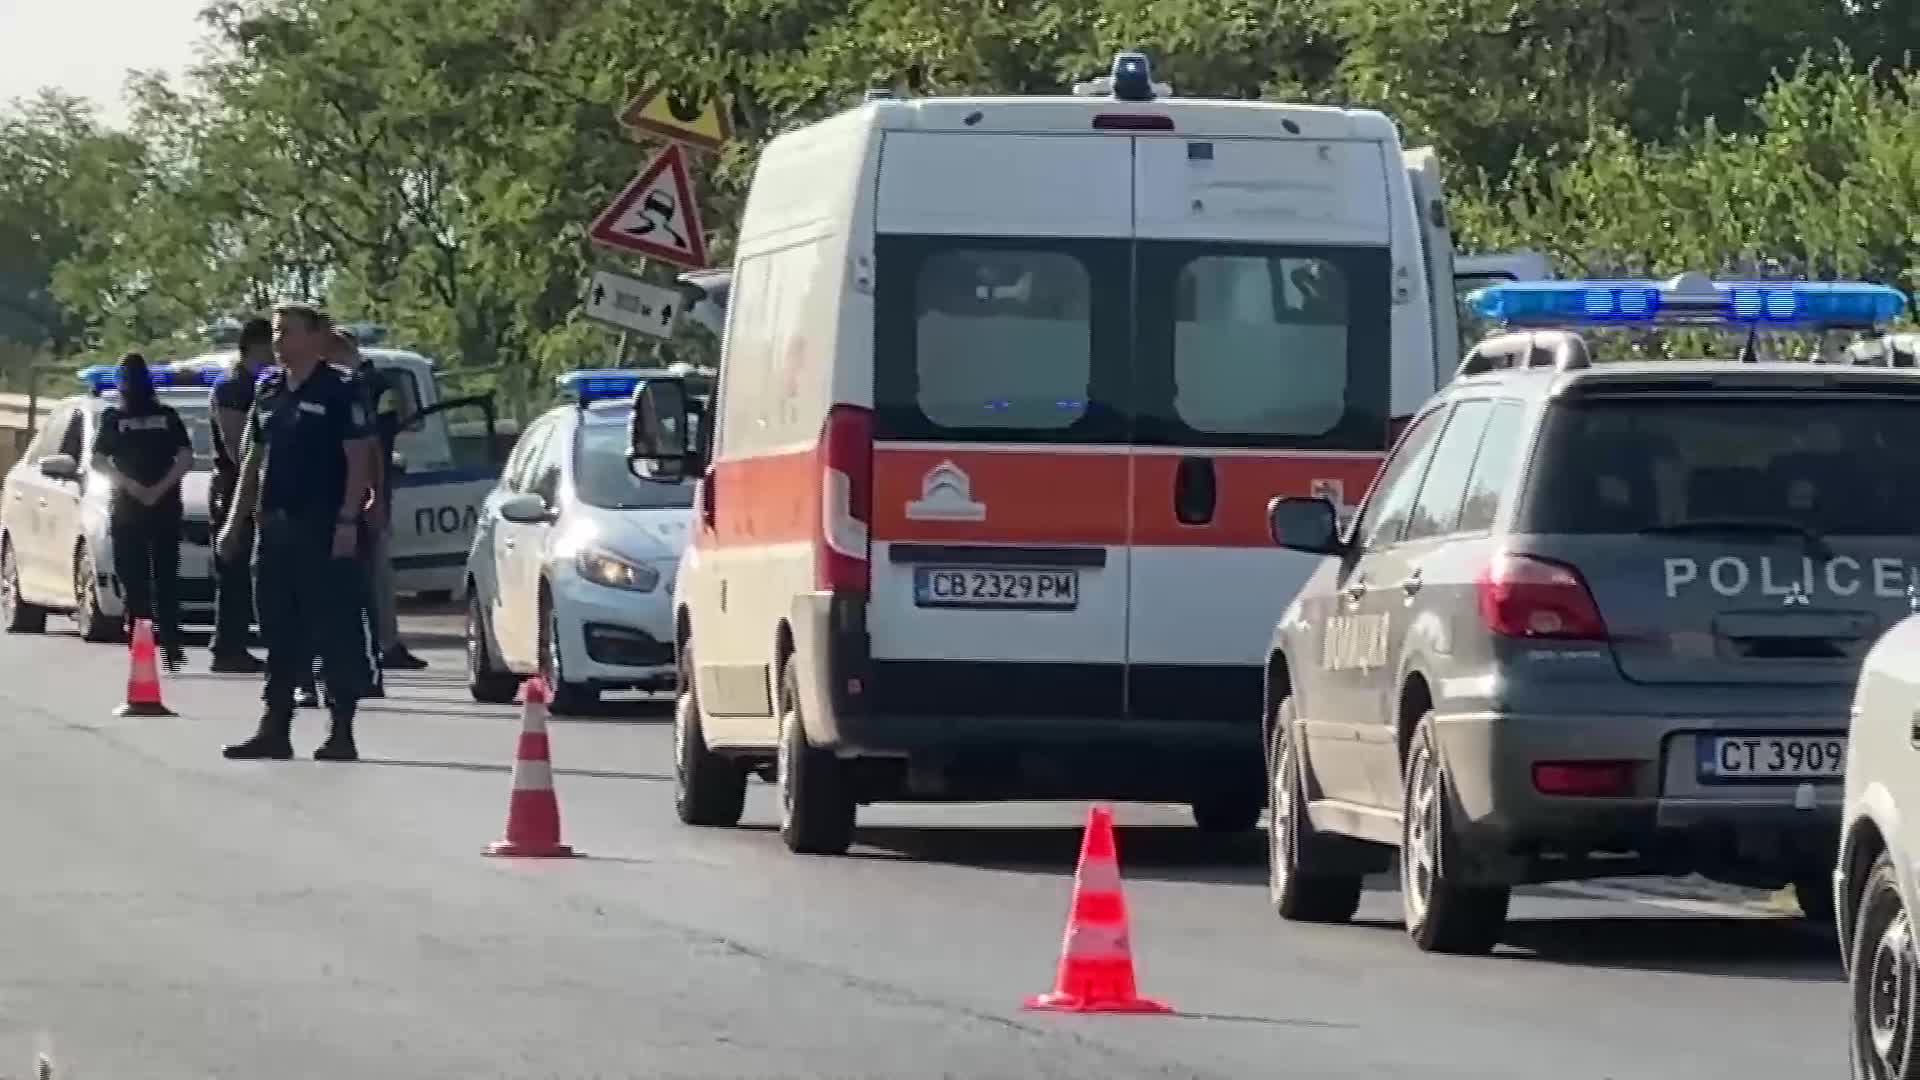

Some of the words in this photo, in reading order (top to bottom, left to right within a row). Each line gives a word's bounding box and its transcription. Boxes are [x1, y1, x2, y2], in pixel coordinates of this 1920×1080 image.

[934, 573, 966, 597] CB
[972, 574, 1033, 599] 2329
[1037, 575, 1071, 598] PM
[1664, 555, 1905, 598] POLICE
[1721, 741, 1760, 771] CT
[1767, 741, 1841, 771] 3909
